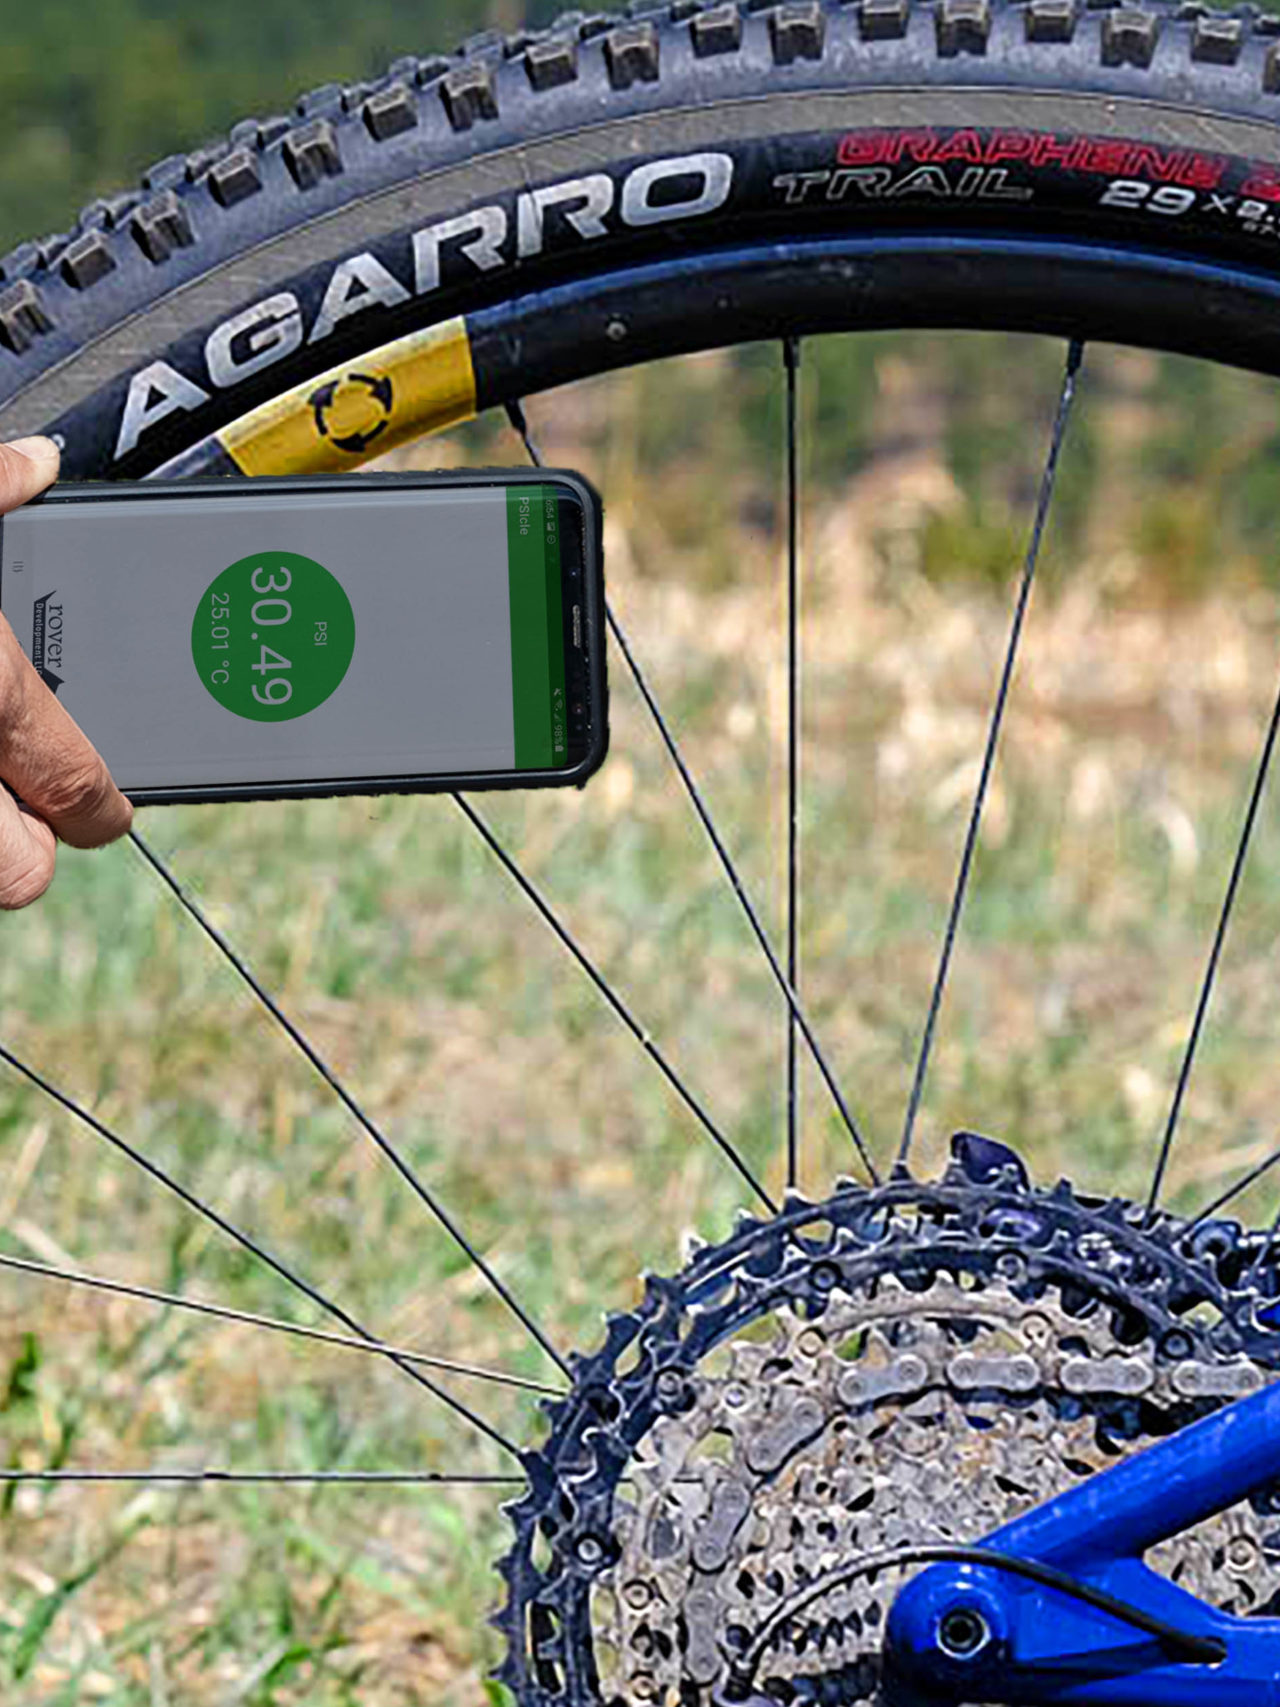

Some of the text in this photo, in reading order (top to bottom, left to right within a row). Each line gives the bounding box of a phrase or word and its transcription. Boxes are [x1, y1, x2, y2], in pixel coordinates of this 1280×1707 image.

[772, 165, 1034, 203] TRAIL
[836, 126, 1228, 190] GRAPHENE
[113, 152, 734, 461] AGARRO
[33, 602, 45, 660] Development
[47, 603, 64, 668] rover
[211, 592, 230, 650] 25.01
[250, 566, 293, 706] 30.49
[314, 621, 328, 646] PSI
[554, 724, 564, 745] 98%
